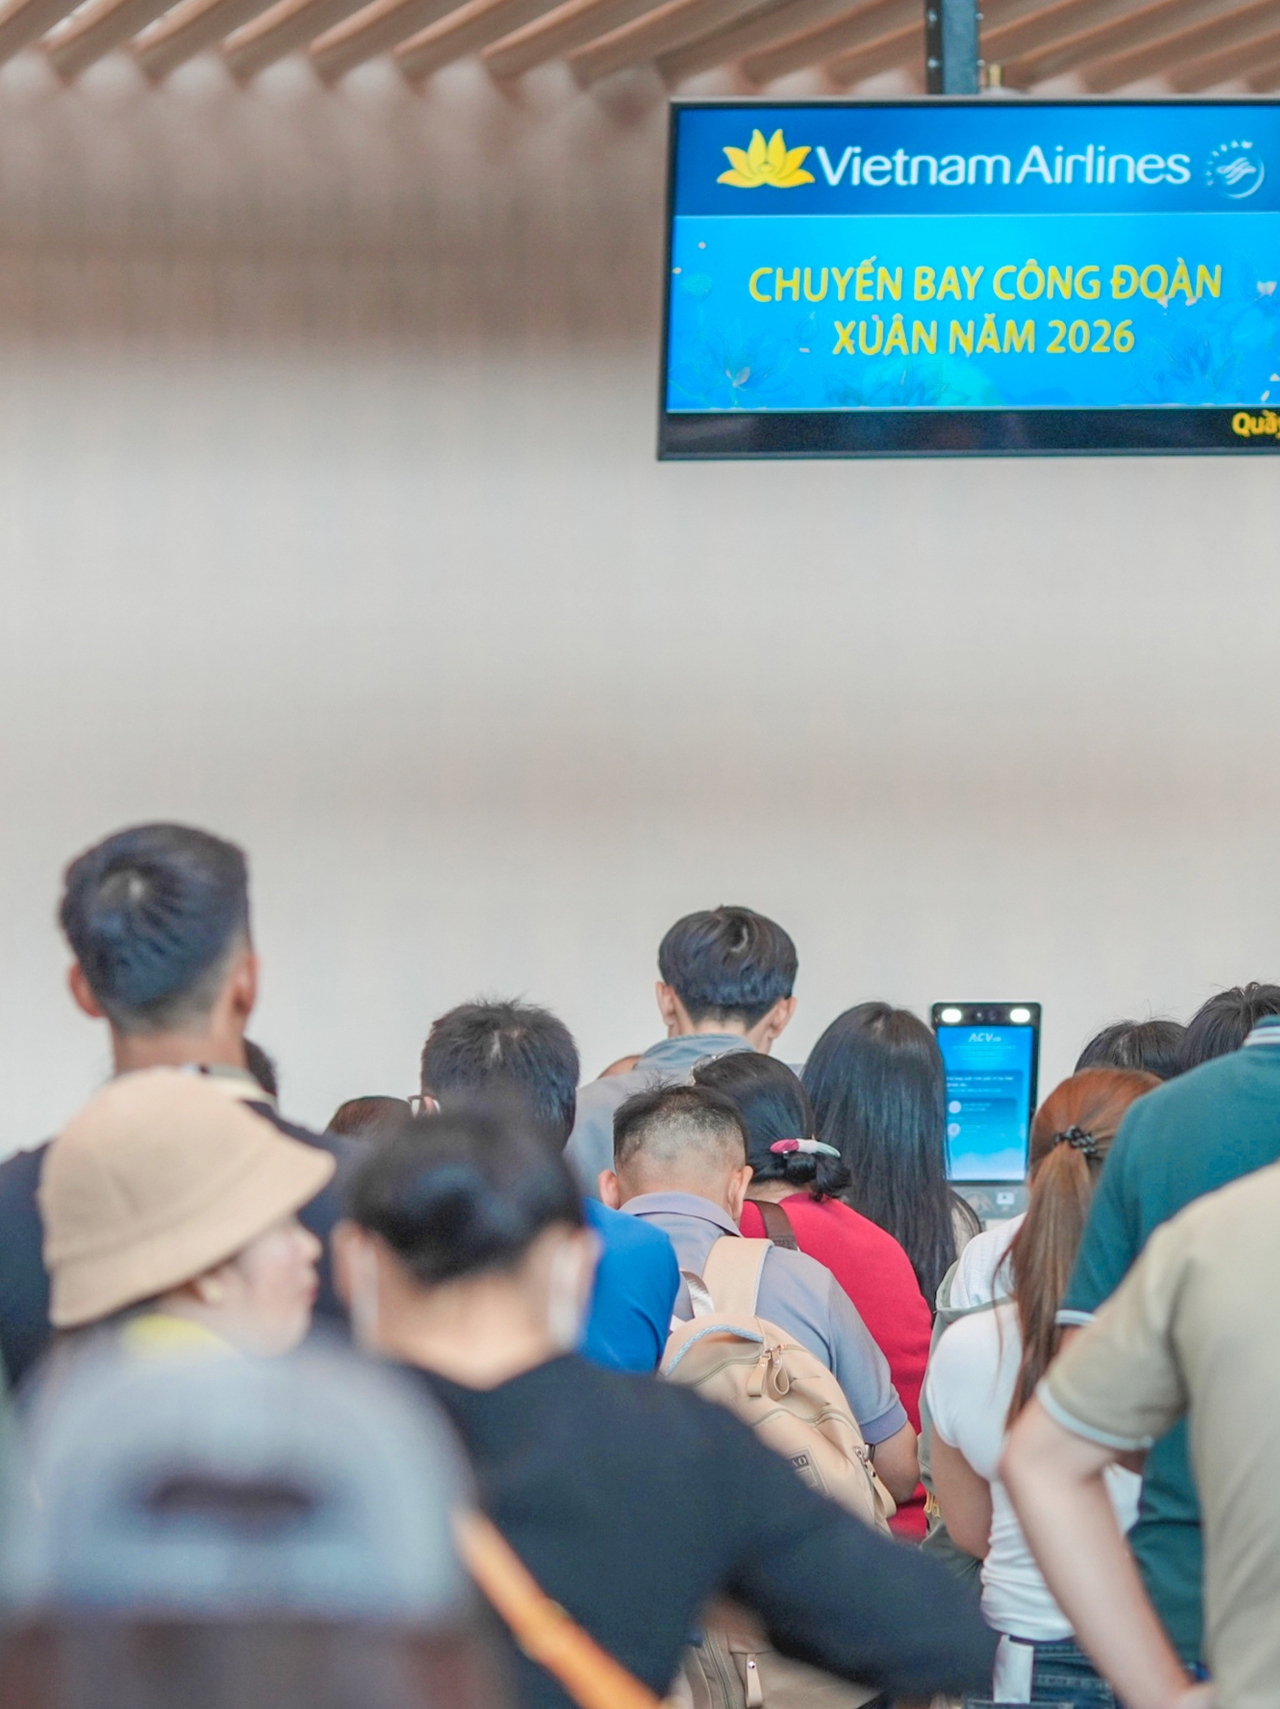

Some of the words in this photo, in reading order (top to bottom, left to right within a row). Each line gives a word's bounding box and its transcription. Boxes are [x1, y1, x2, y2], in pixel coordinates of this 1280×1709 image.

[815, 145, 1011, 187] Vietnam
[1015, 143, 1192, 185] Airlines
[748, 255, 903, 303] CHUYẾN
[913, 264, 985, 301] BAY
[992, 258, 1101, 301] CÔNG
[948, 312, 1036, 356] NĂM
[1047, 319, 1136, 354] 2026
